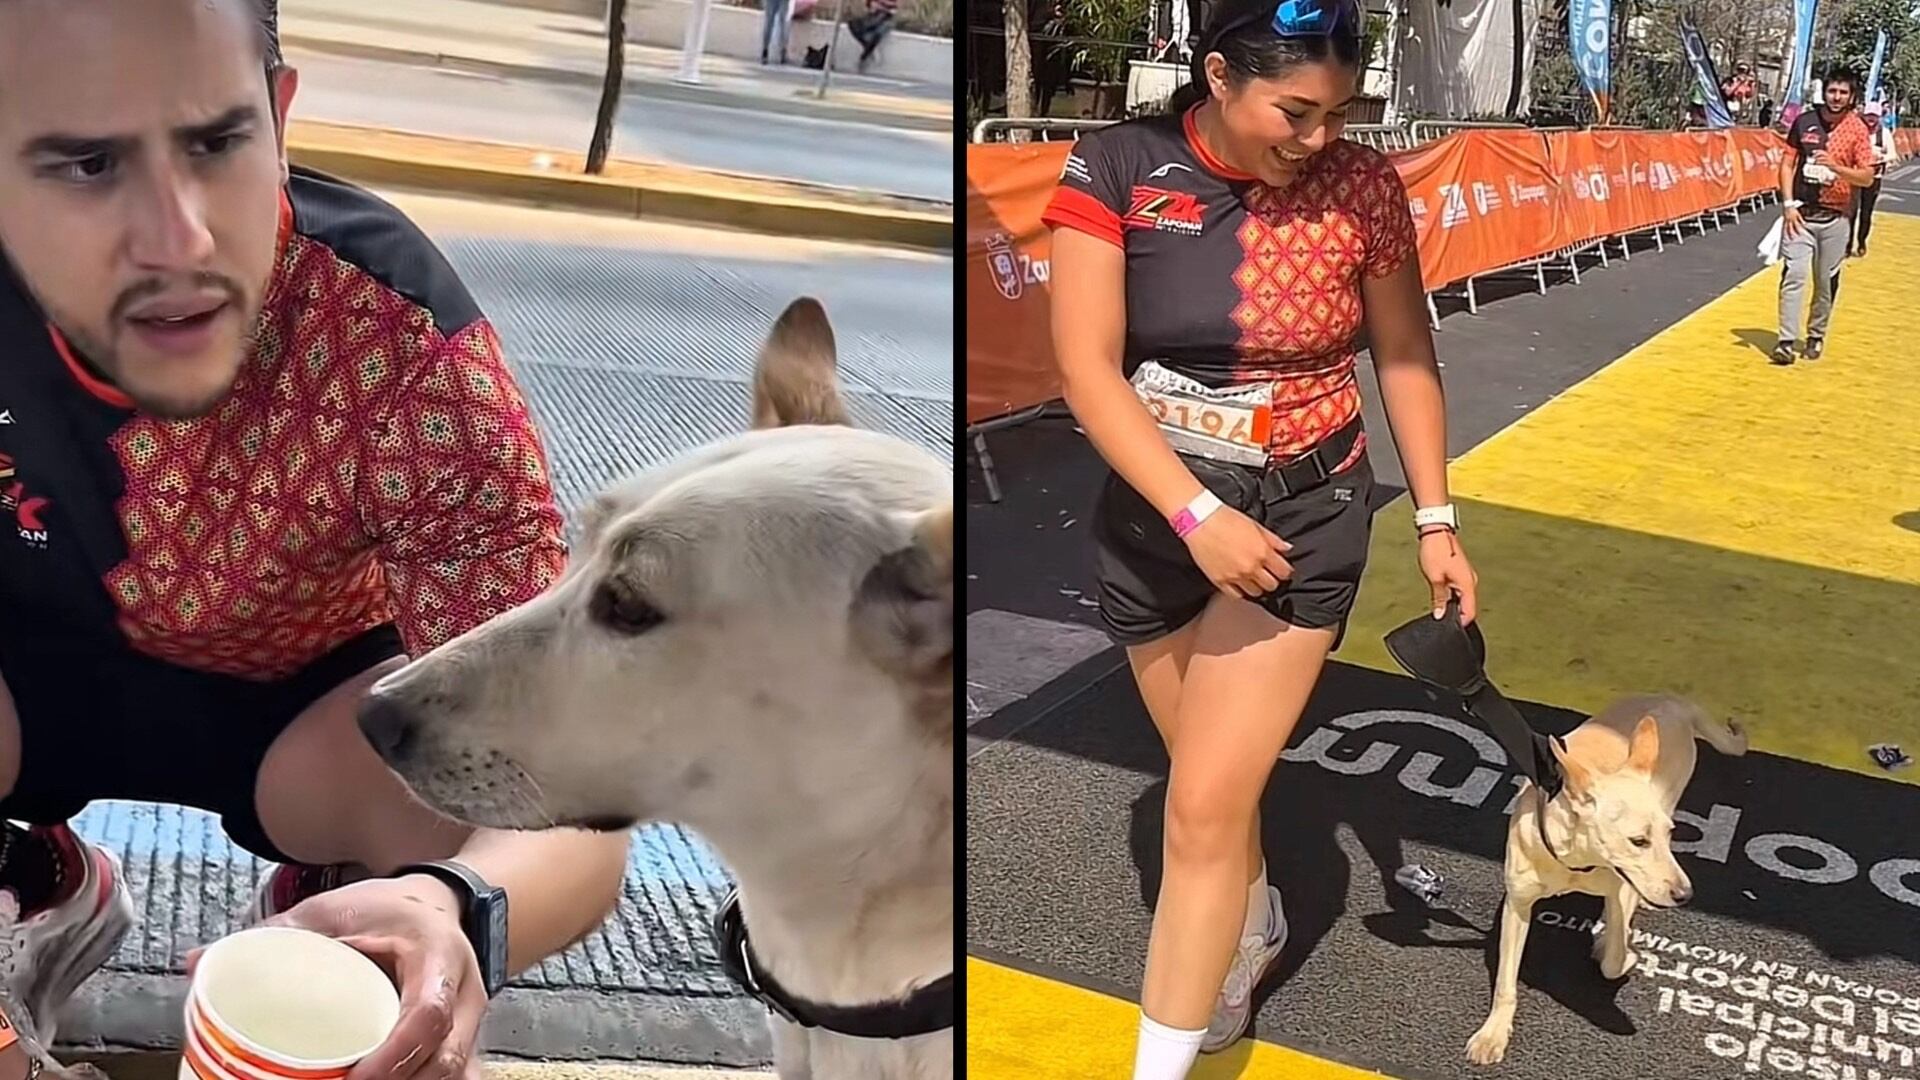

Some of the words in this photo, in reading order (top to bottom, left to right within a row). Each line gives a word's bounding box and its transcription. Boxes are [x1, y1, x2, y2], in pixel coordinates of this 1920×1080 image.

[1018, 254, 1050, 284] Za
[1536, 910, 1748, 970] MOVIMNTO
[1751, 960, 1799, 981] EN
[1657, 986, 1920, 1068] unicipal
